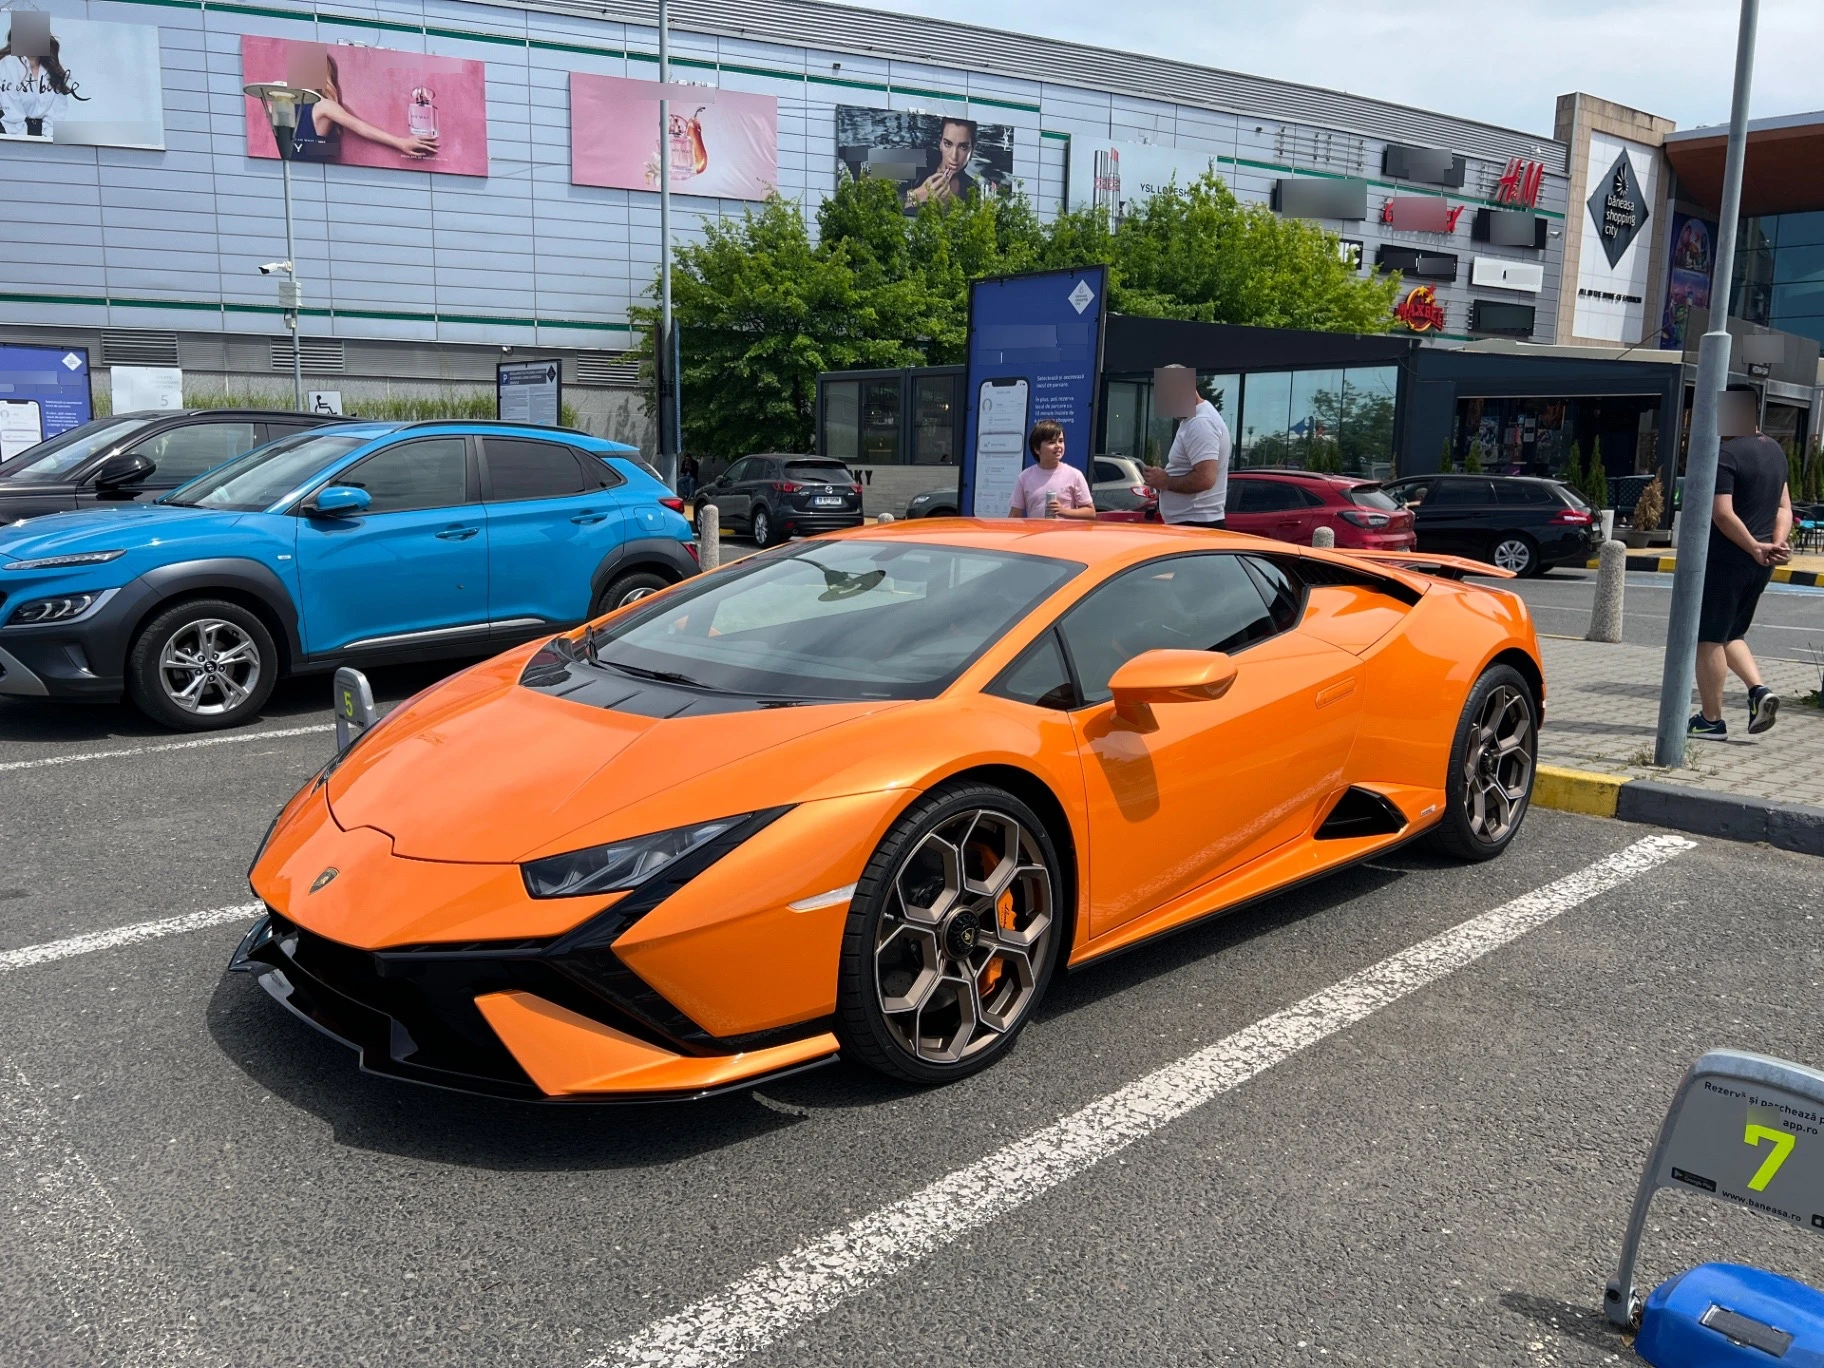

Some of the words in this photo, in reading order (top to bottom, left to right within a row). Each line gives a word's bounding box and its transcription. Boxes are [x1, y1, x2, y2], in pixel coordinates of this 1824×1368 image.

[1140, 183, 1156, 194] YSL
[1495, 157, 1544, 209] H&M
[1607, 194, 1635, 211] băneasa
[1606, 208, 1636, 227] shopping
[1604, 224, 1619, 239] city
[161, 395, 168, 407] 5
[343, 691, 353, 717] 5
[1748, 1096, 1759, 1106] și
[1761, 1099, 1817, 1121] pchează
[1782, 1119, 1819, 1135] app.ro
[1743, 1124, 1796, 1192] 7
[1721, 1189, 1802, 1222] www.baneasa.ro
